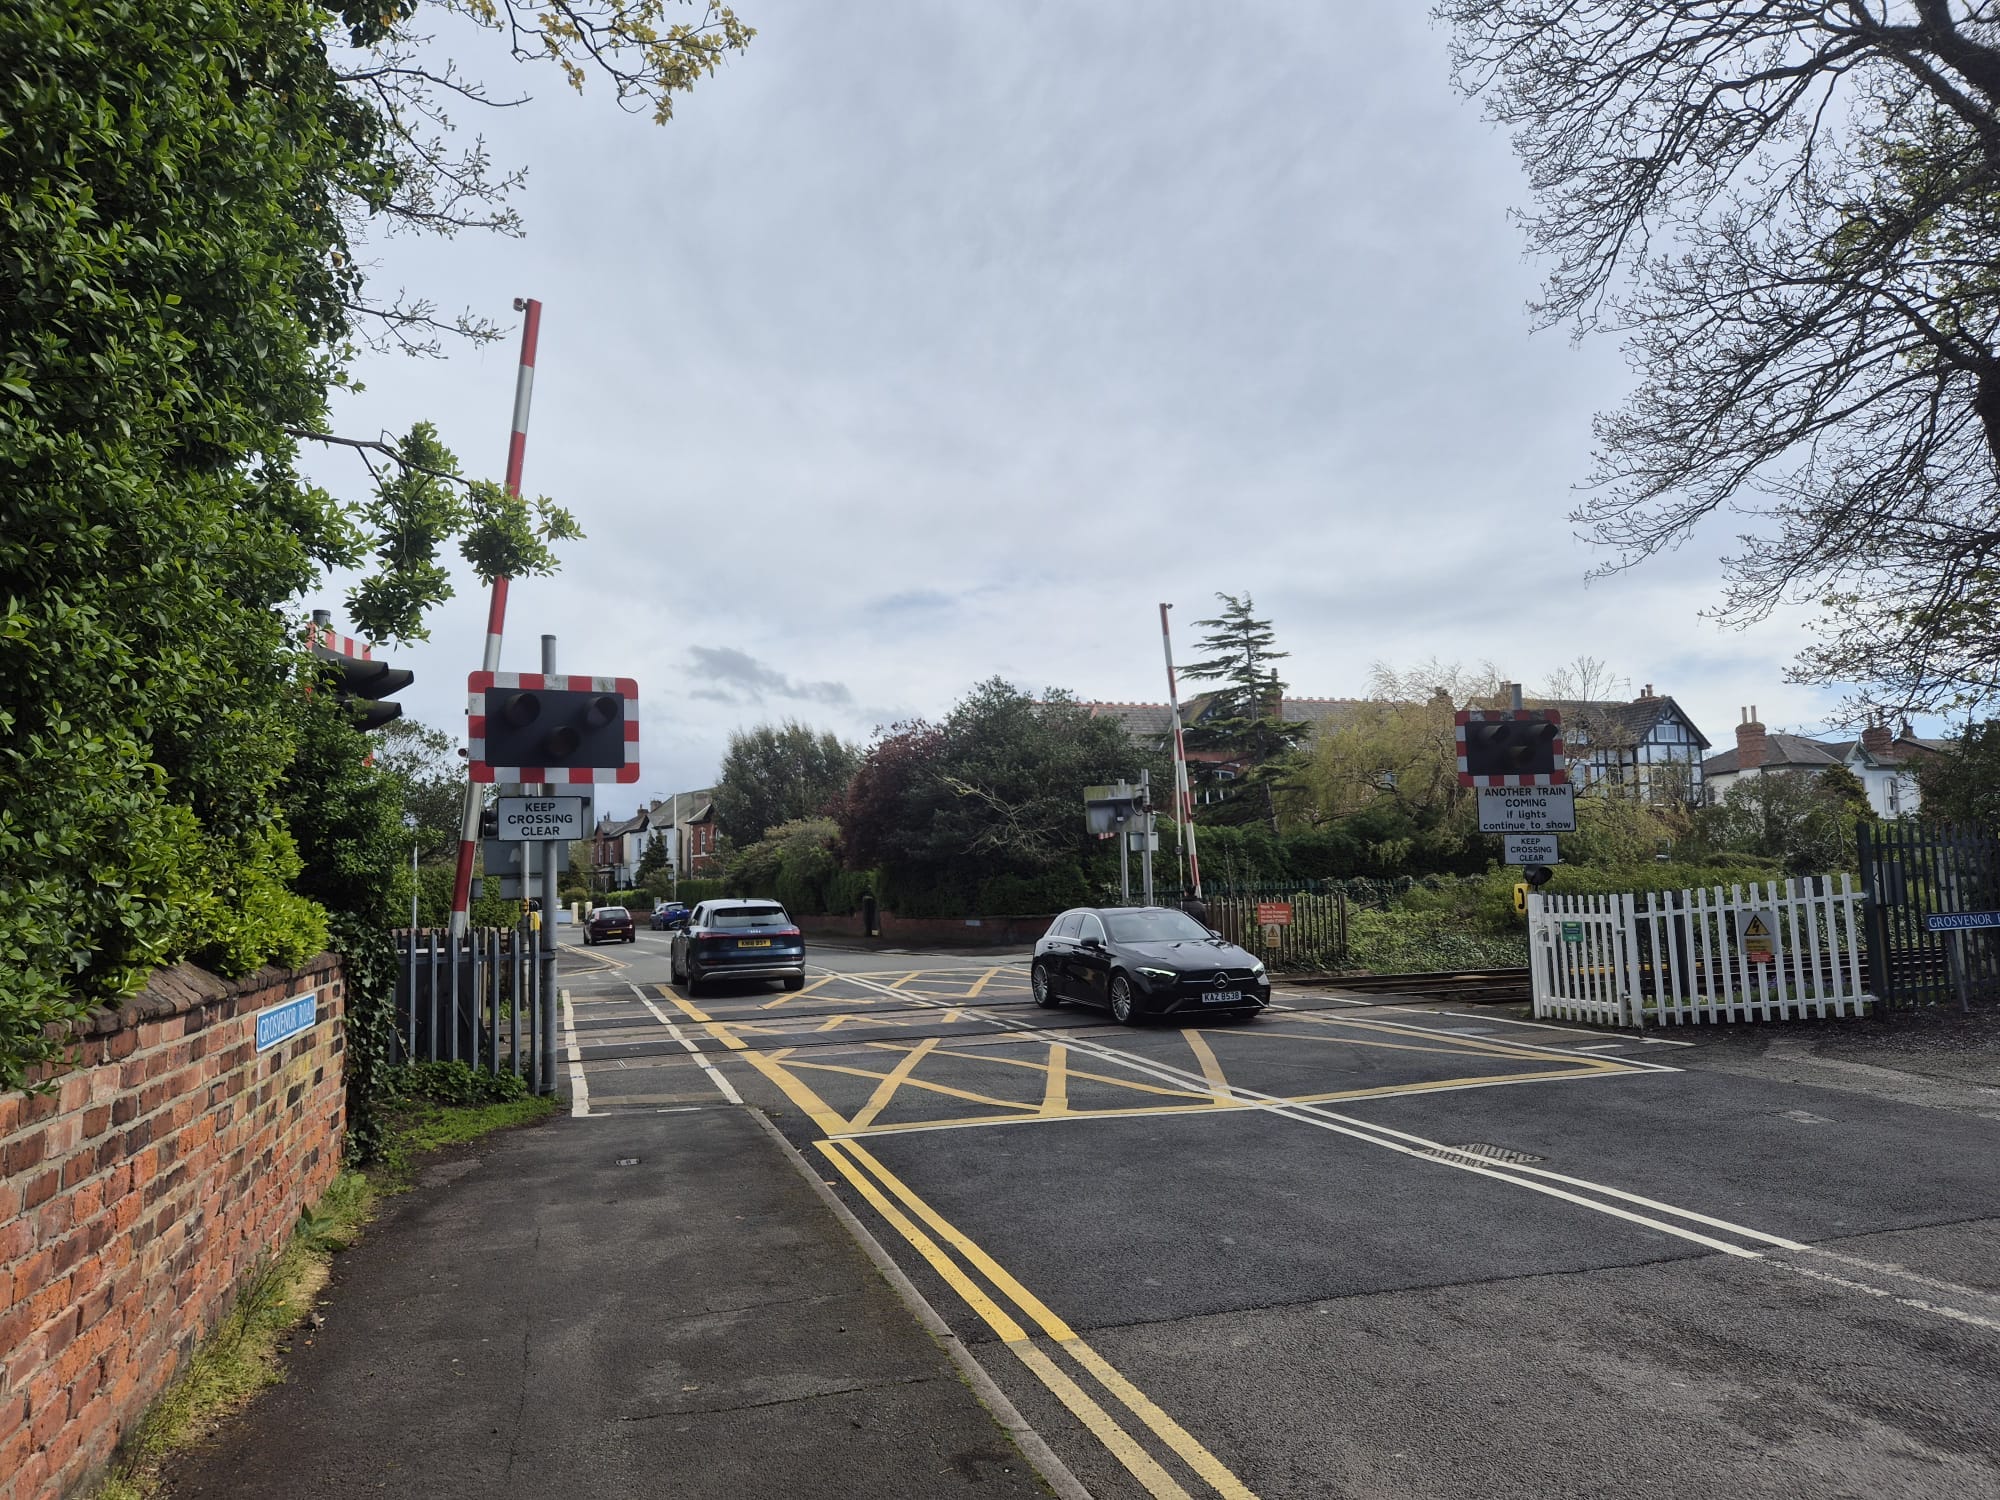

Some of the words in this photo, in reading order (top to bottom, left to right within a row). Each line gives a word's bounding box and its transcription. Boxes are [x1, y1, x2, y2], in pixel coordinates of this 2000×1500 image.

[1484, 787, 1532, 796] ANOTHER
[1537, 787, 1566, 796] TRAIN
[525, 802, 556, 812] KEEP
[1505, 798, 1547, 808] COMING
[507, 814, 573, 824] CROSSING
[1506, 810, 1513, 819] if
[1518, 810, 1547, 820] lights
[1483, 822, 1526, 830] continue
[1546, 820, 1571, 829] show
[521, 826, 560, 836] CLEAR
[1519, 854, 1544, 862] CLEAR
[1929, 914, 1992, 928] GROSVENOR
[260, 1007, 297, 1043] GROSVENOR
[298, 999, 314, 1026] ROAD
